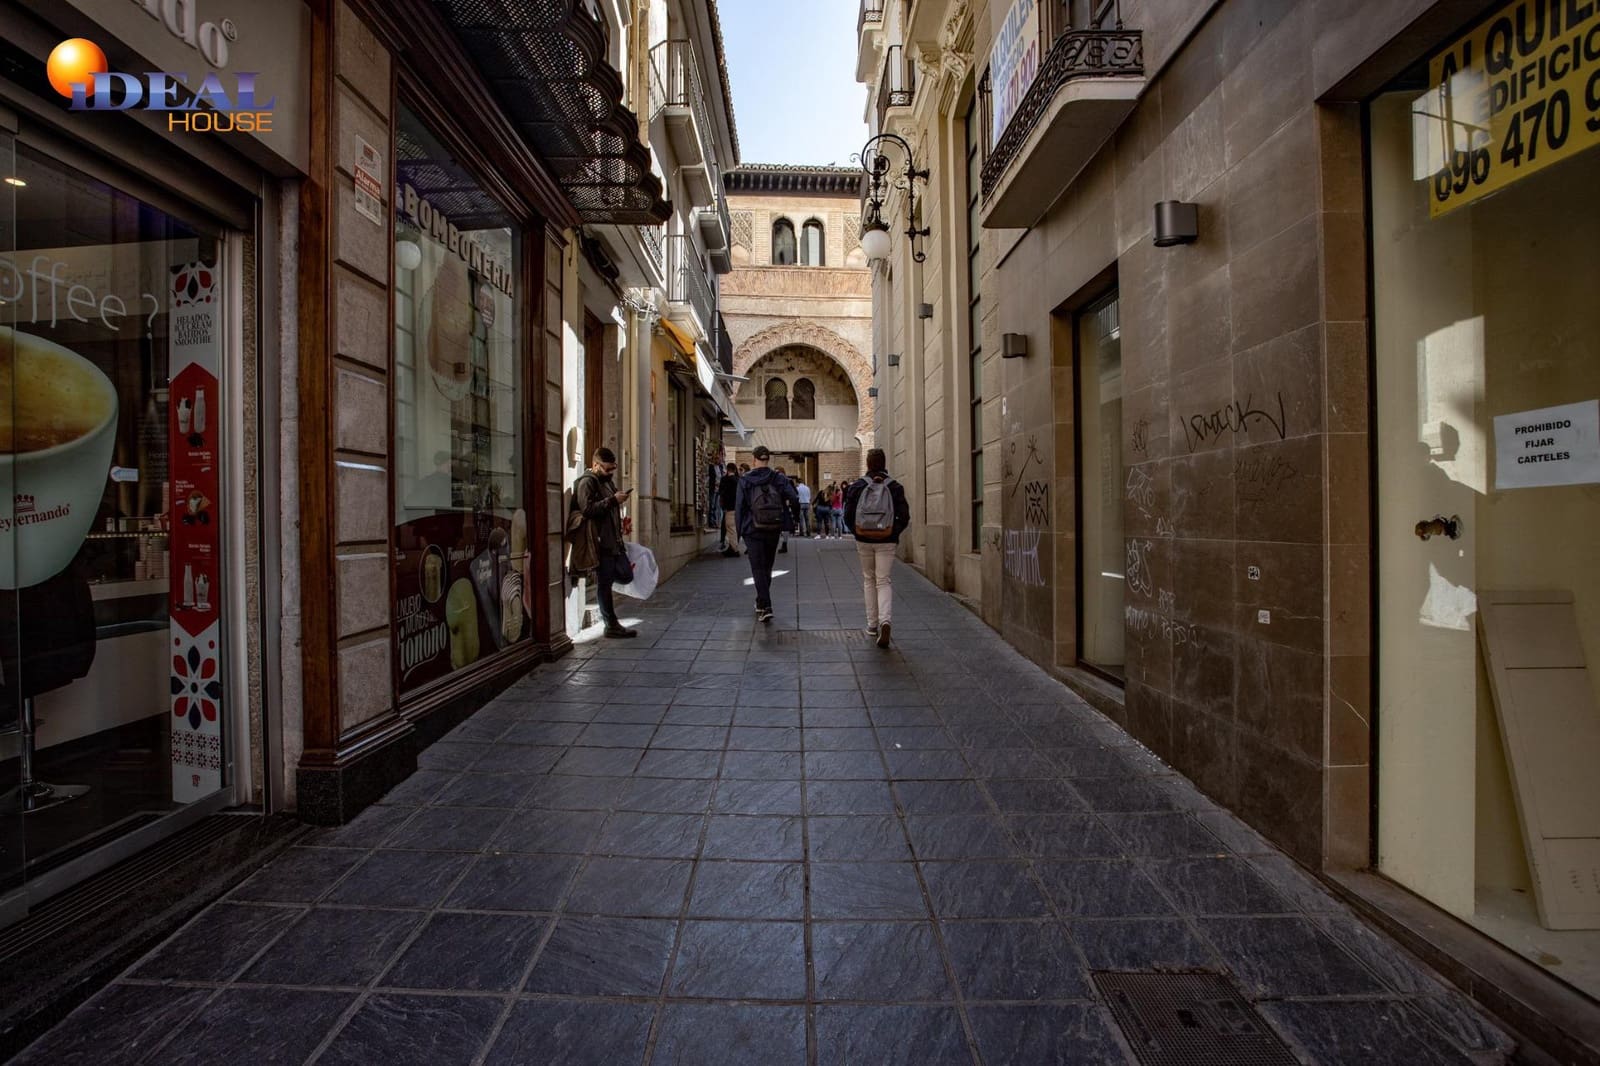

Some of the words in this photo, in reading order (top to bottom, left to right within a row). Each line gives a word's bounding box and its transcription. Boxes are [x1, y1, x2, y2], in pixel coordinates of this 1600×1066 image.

[1500, 89, 1570, 168] 470
[1514, 420, 1572, 435] PROHIBIDO
[1525, 438, 1555, 448] FIJAR
[1517, 451, 1571, 464] CARTELES
